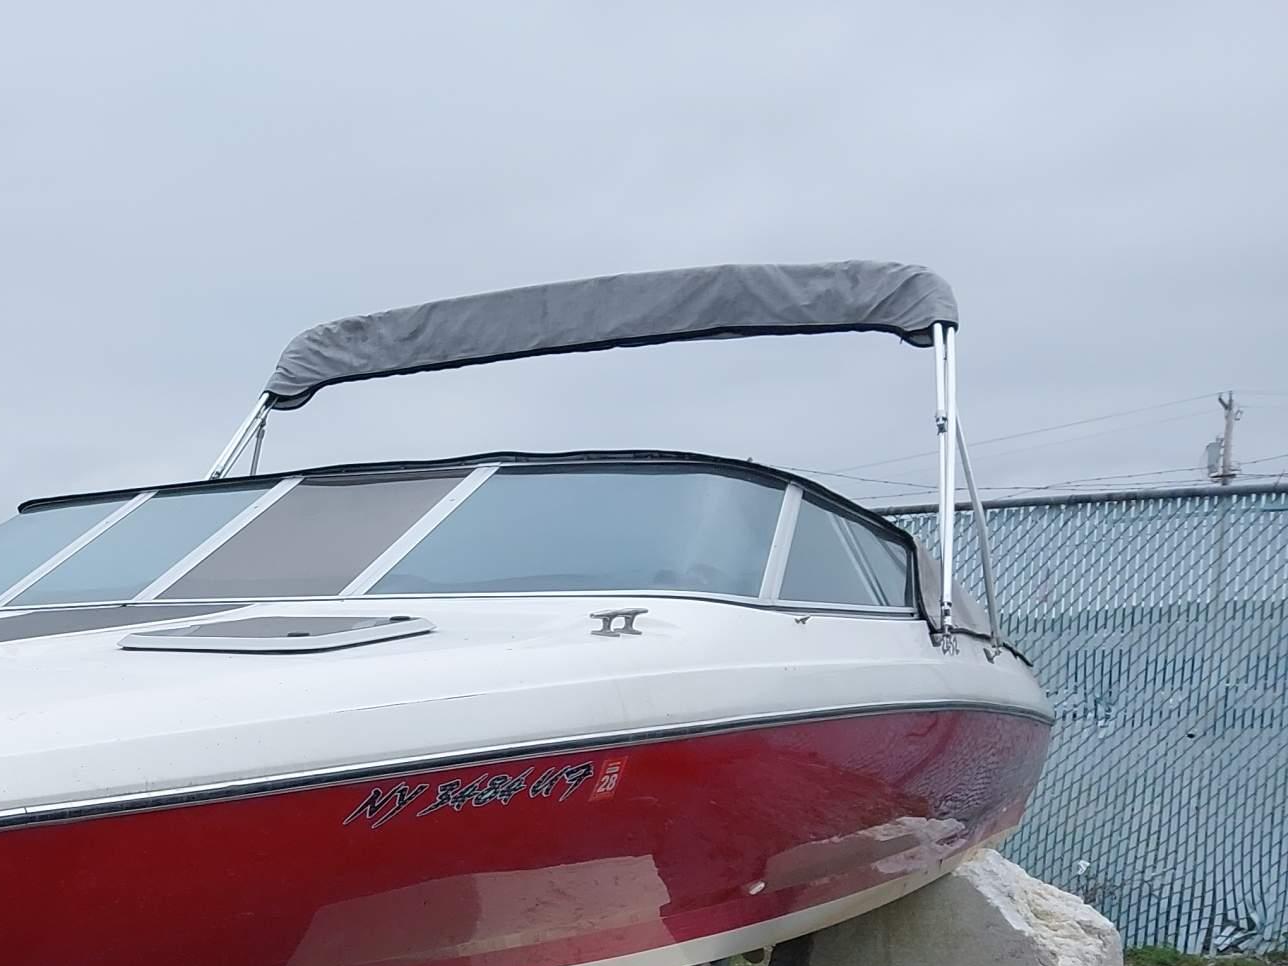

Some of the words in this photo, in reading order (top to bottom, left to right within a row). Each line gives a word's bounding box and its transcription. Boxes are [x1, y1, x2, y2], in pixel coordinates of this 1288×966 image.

[342, 781, 430, 830] NY
[415, 766, 533, 818] 3484
[596, 773, 619, 793] 28
